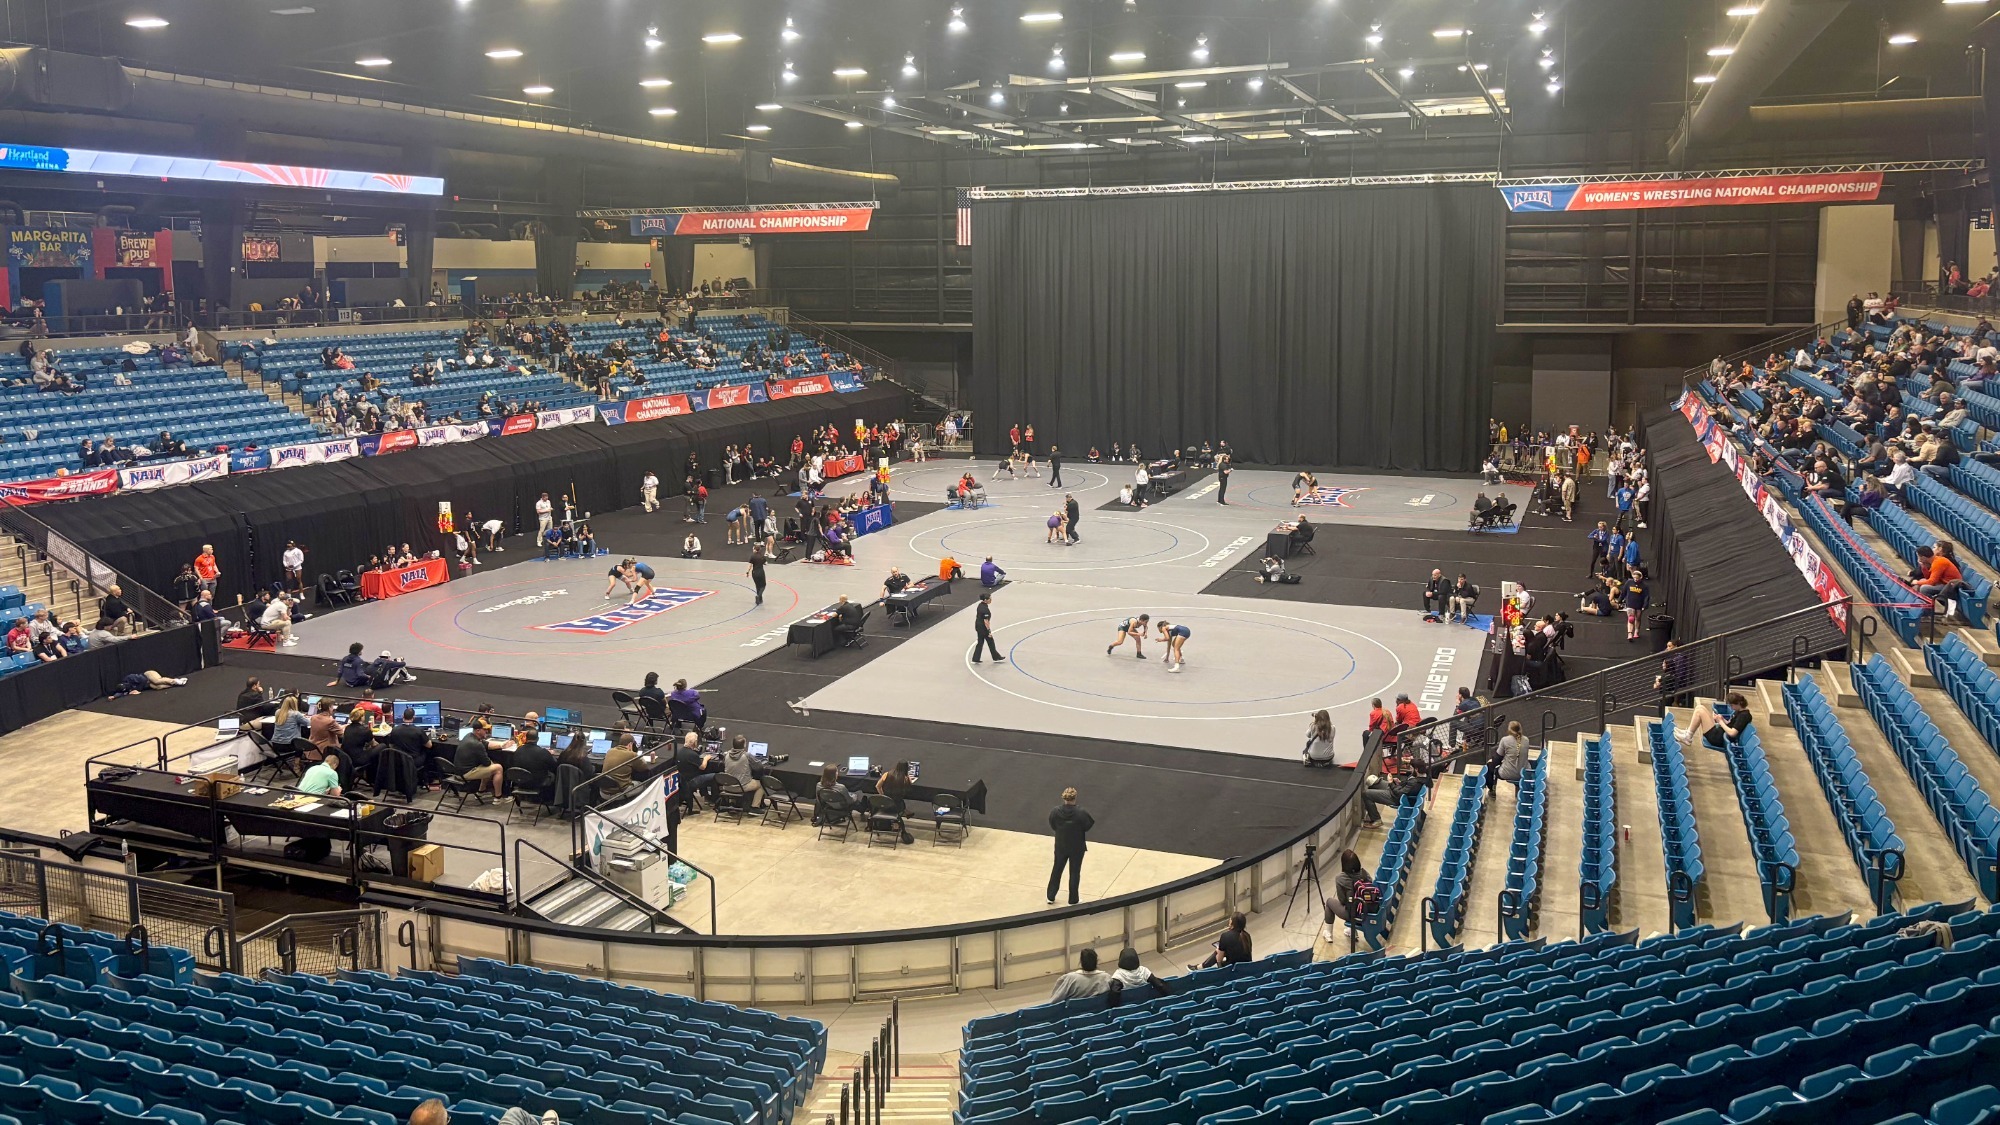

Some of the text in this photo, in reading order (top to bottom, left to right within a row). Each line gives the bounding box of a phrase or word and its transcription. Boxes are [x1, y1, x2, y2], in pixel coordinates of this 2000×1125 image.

[8, 148, 49, 160] Heartland
[36, 162, 60, 170] ARENA
[1513, 190, 1552, 207] NAIA
[1585, 182, 1878, 202] WOMEN'S WRESTLING NATIONAL CHAMPIONSHIP
[640, 218, 666, 232] NAIA
[702, 215, 848, 230] NATIONAL CHAMPIONSHIP
[11, 230, 88, 243] MARGARITA
[120, 236, 149, 249] BREW
[39, 241, 62, 251] BAR
[130, 249, 150, 261] PUB
[339, 311, 350, 319] 113
[642, 398, 671, 409] NATIONAL
[636, 406, 681, 419] CHAMPIONSHIP
[276, 446, 306, 467] NAIA
[324, 443, 352, 460] NAIA
[188, 457, 222, 478] NAIA
[129, 467, 166, 487] NAIA
[400, 566, 429, 588] NAIA
